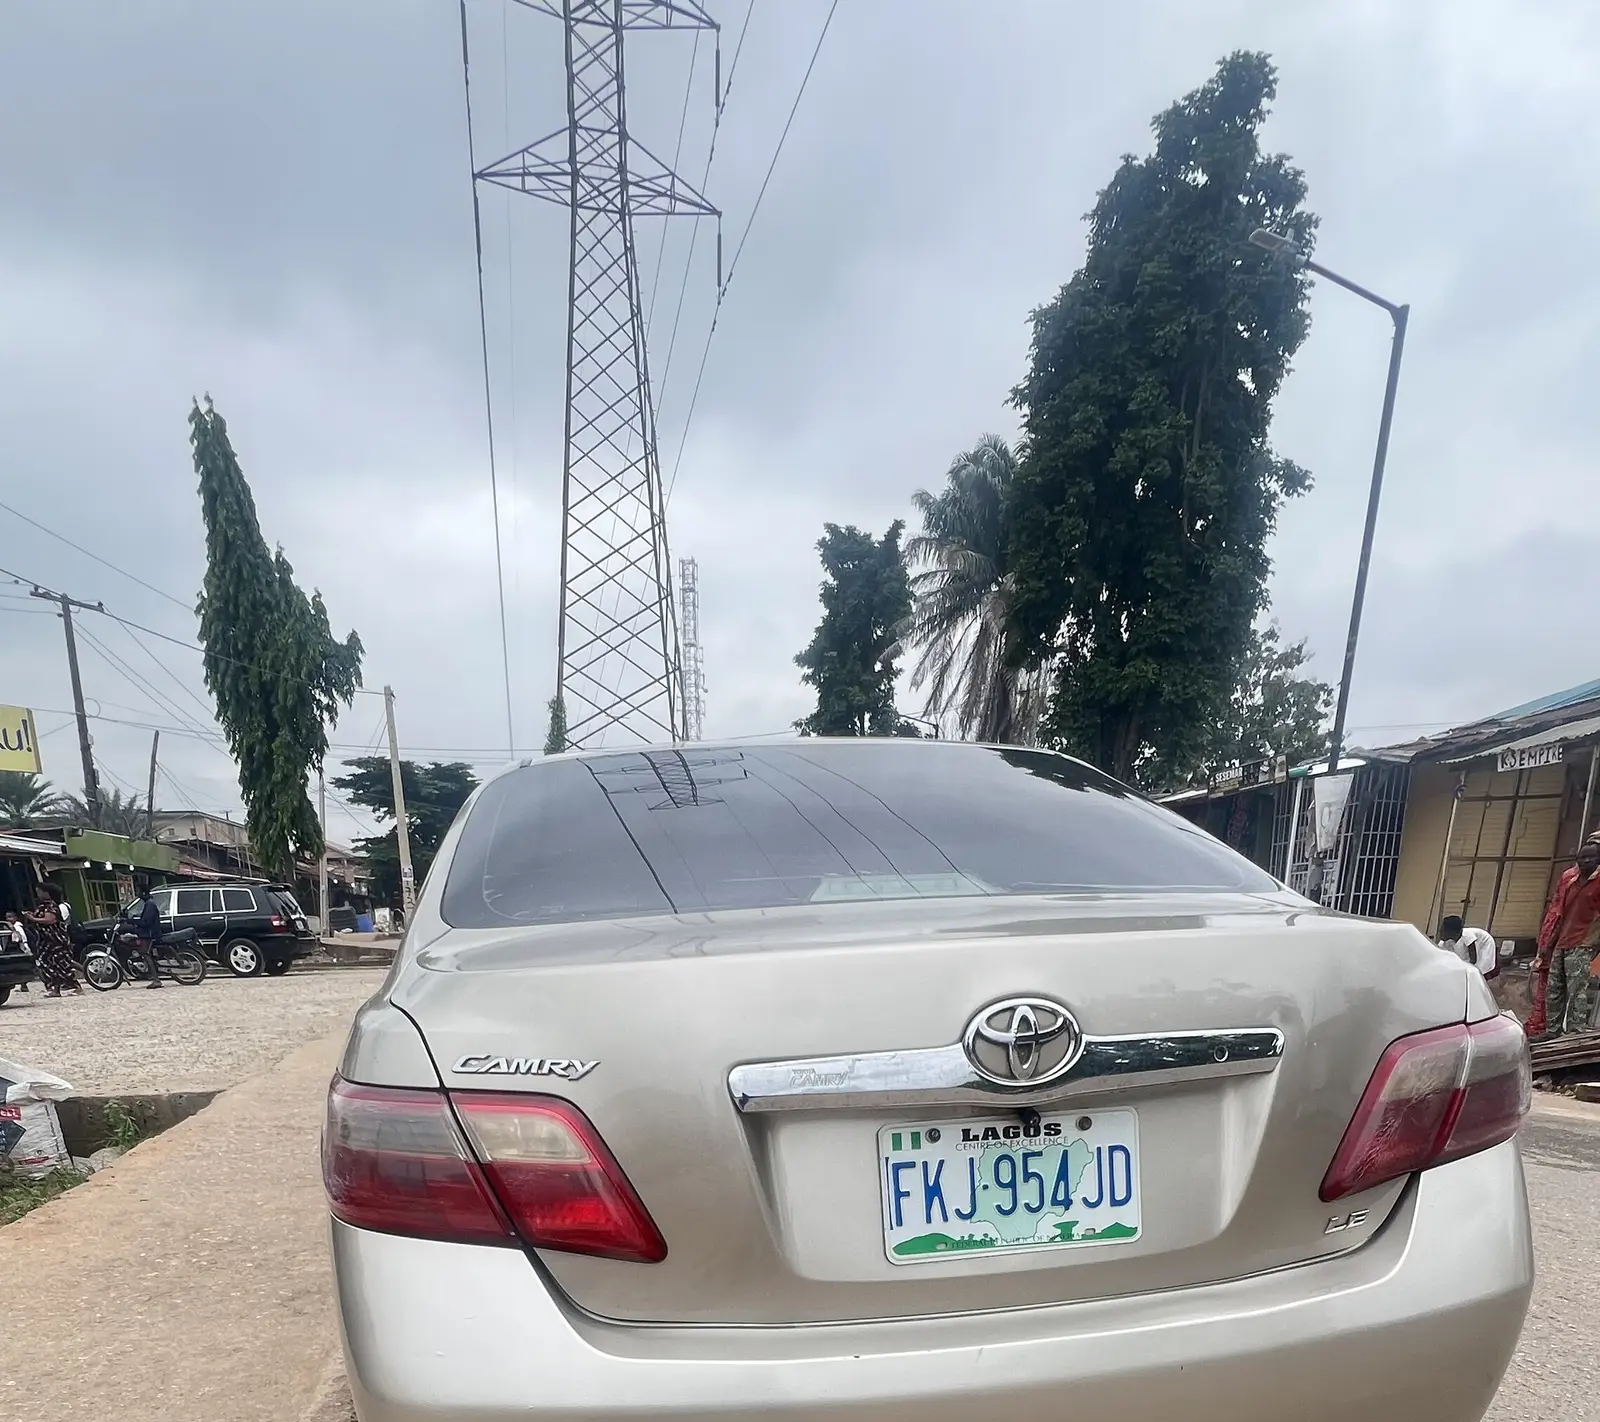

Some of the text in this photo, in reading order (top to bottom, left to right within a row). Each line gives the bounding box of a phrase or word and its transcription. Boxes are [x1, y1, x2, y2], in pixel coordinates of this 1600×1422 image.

[451, 1054, 601, 1081] CAMRY
[955, 1135, 1070, 1152] CENTRE OF EXCELLENCE
[961, 1122, 1062, 1142] LAGOS
[1324, 1208, 1370, 1235] LE
